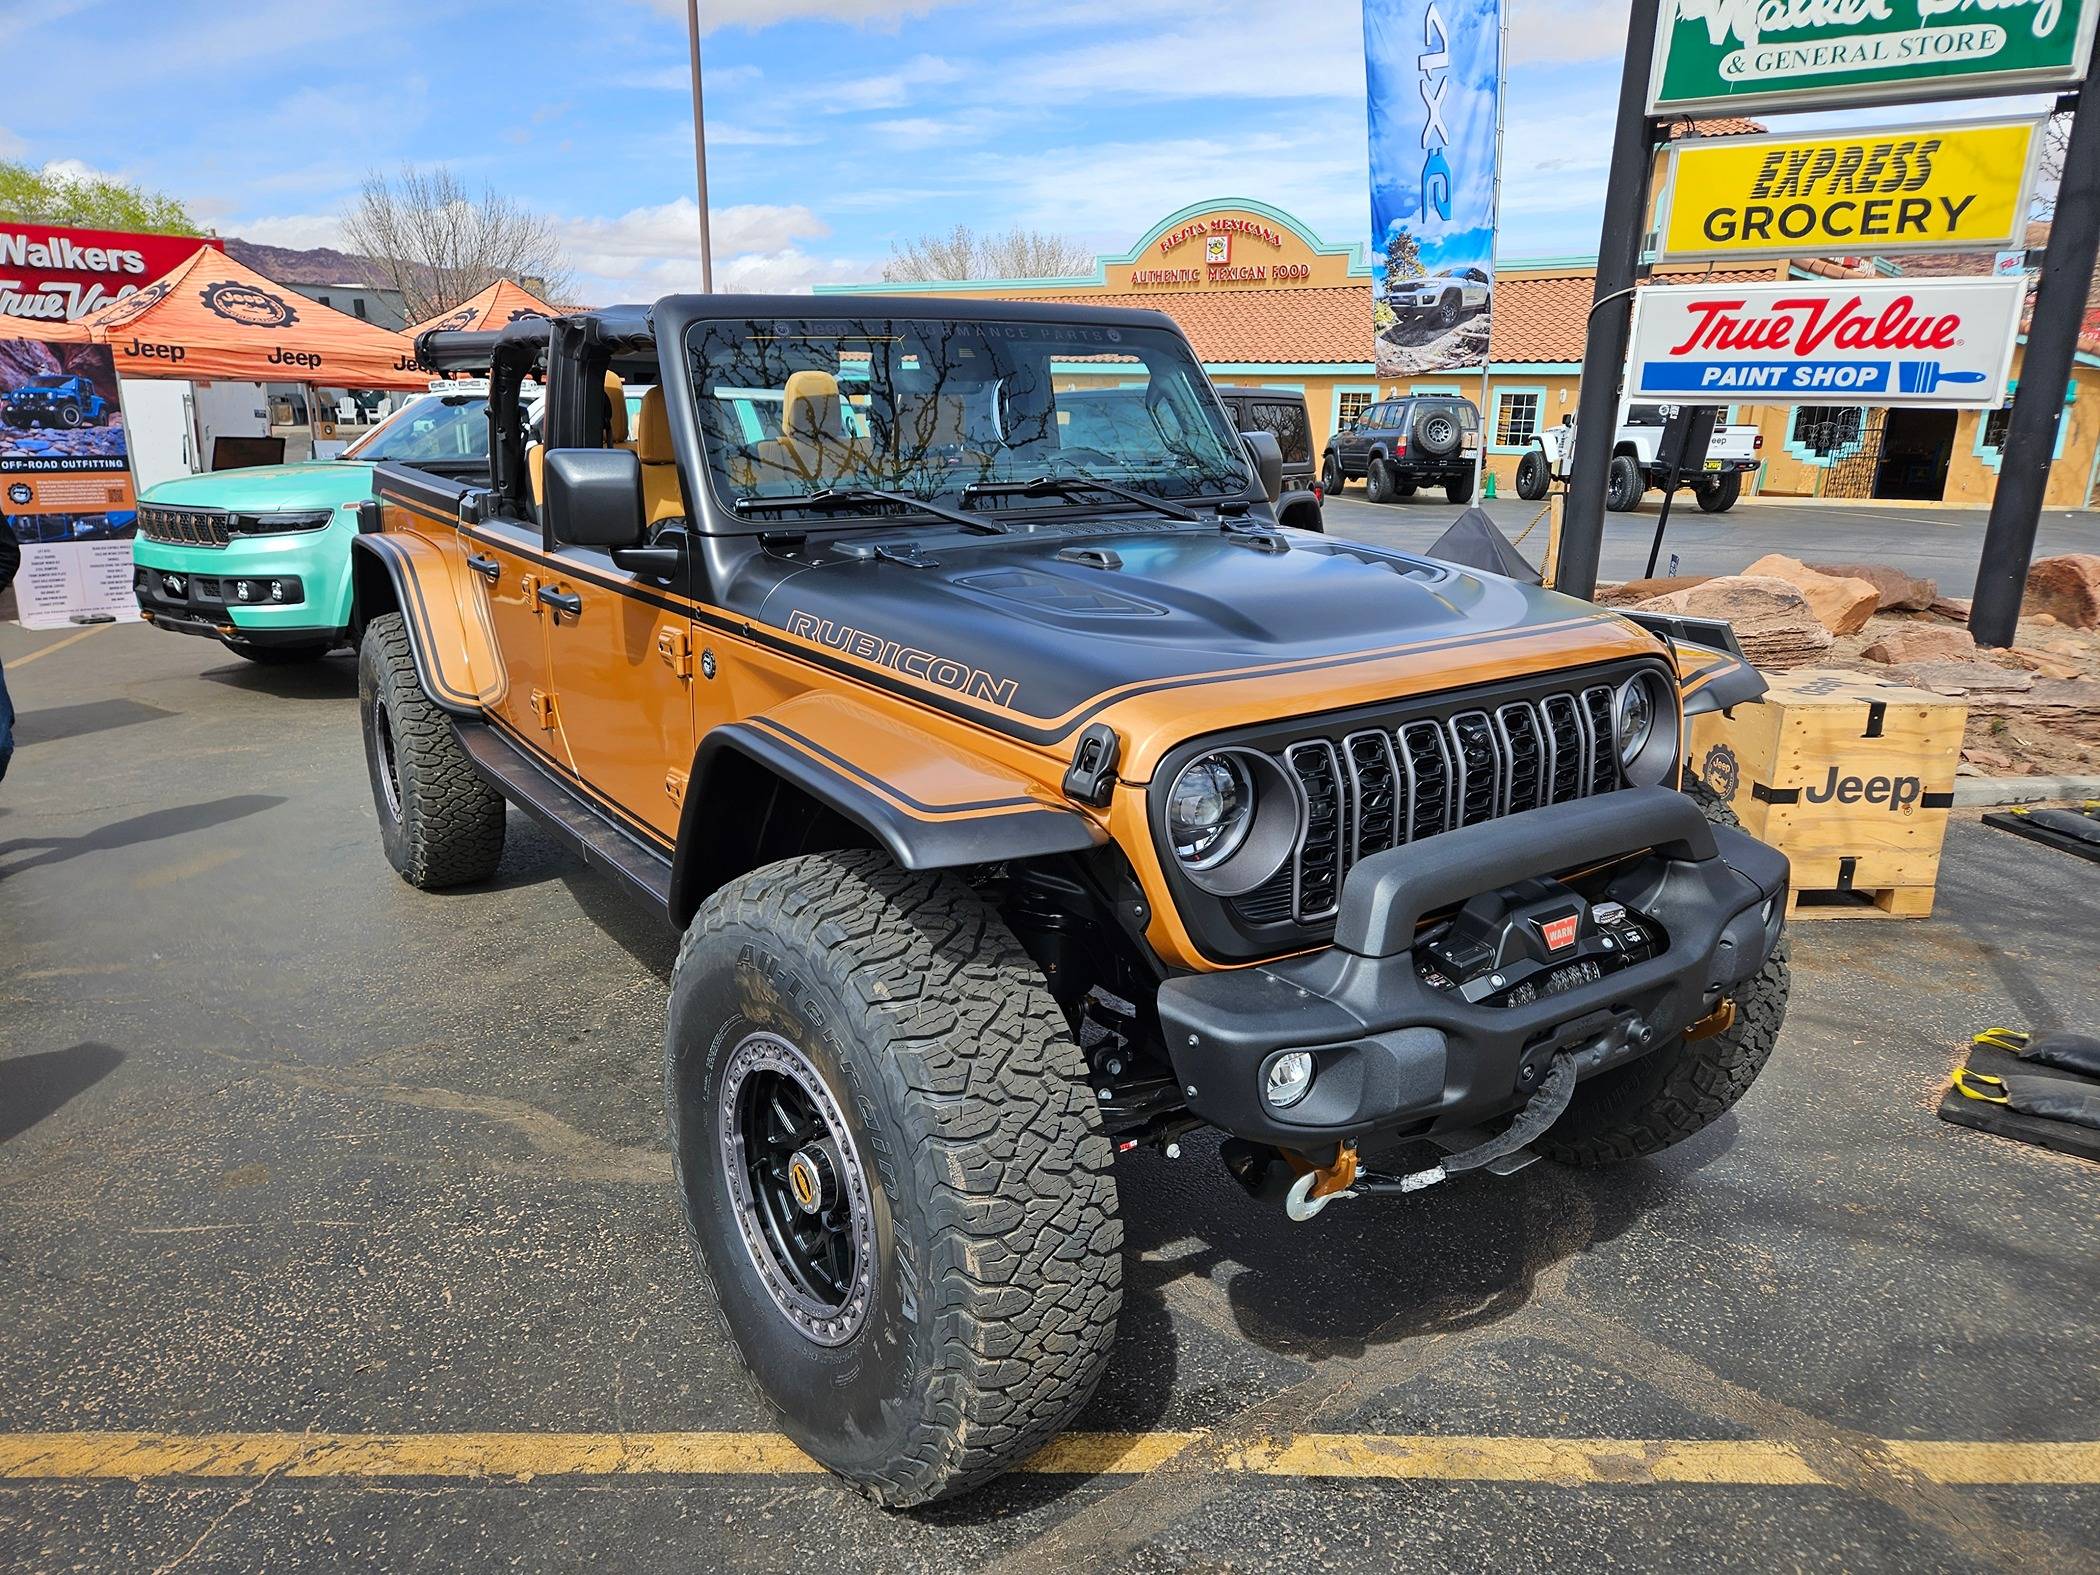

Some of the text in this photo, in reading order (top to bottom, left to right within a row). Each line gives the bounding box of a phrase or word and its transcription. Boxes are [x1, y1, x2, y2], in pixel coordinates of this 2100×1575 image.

[1726, 29, 1998, 76] & GENERAL STORE
[1750, 139, 1943, 200] EXPRESS
[1702, 194, 1978, 242] GROCERY
[1160, 218, 1282, 253] FIESTA MEXICANA
[1131, 264, 1311, 284] AUTHENTIC MEXICAN FOOD
[1040, 327, 1103, 341] PARTS
[124, 337, 185, 363] Jeep
[267, 346, 322, 371] Jeep
[1701, 365, 1879, 387] PAINT SHOP
[1711, 437, 1727, 446] eep
[1, 459, 124, 470] OFF-ROAD OUTFITTING
[786, 609, 1020, 709] RUBICON
[1805, 766, 1921, 811] Jeep
[1549, 926, 1574, 942] WARN
